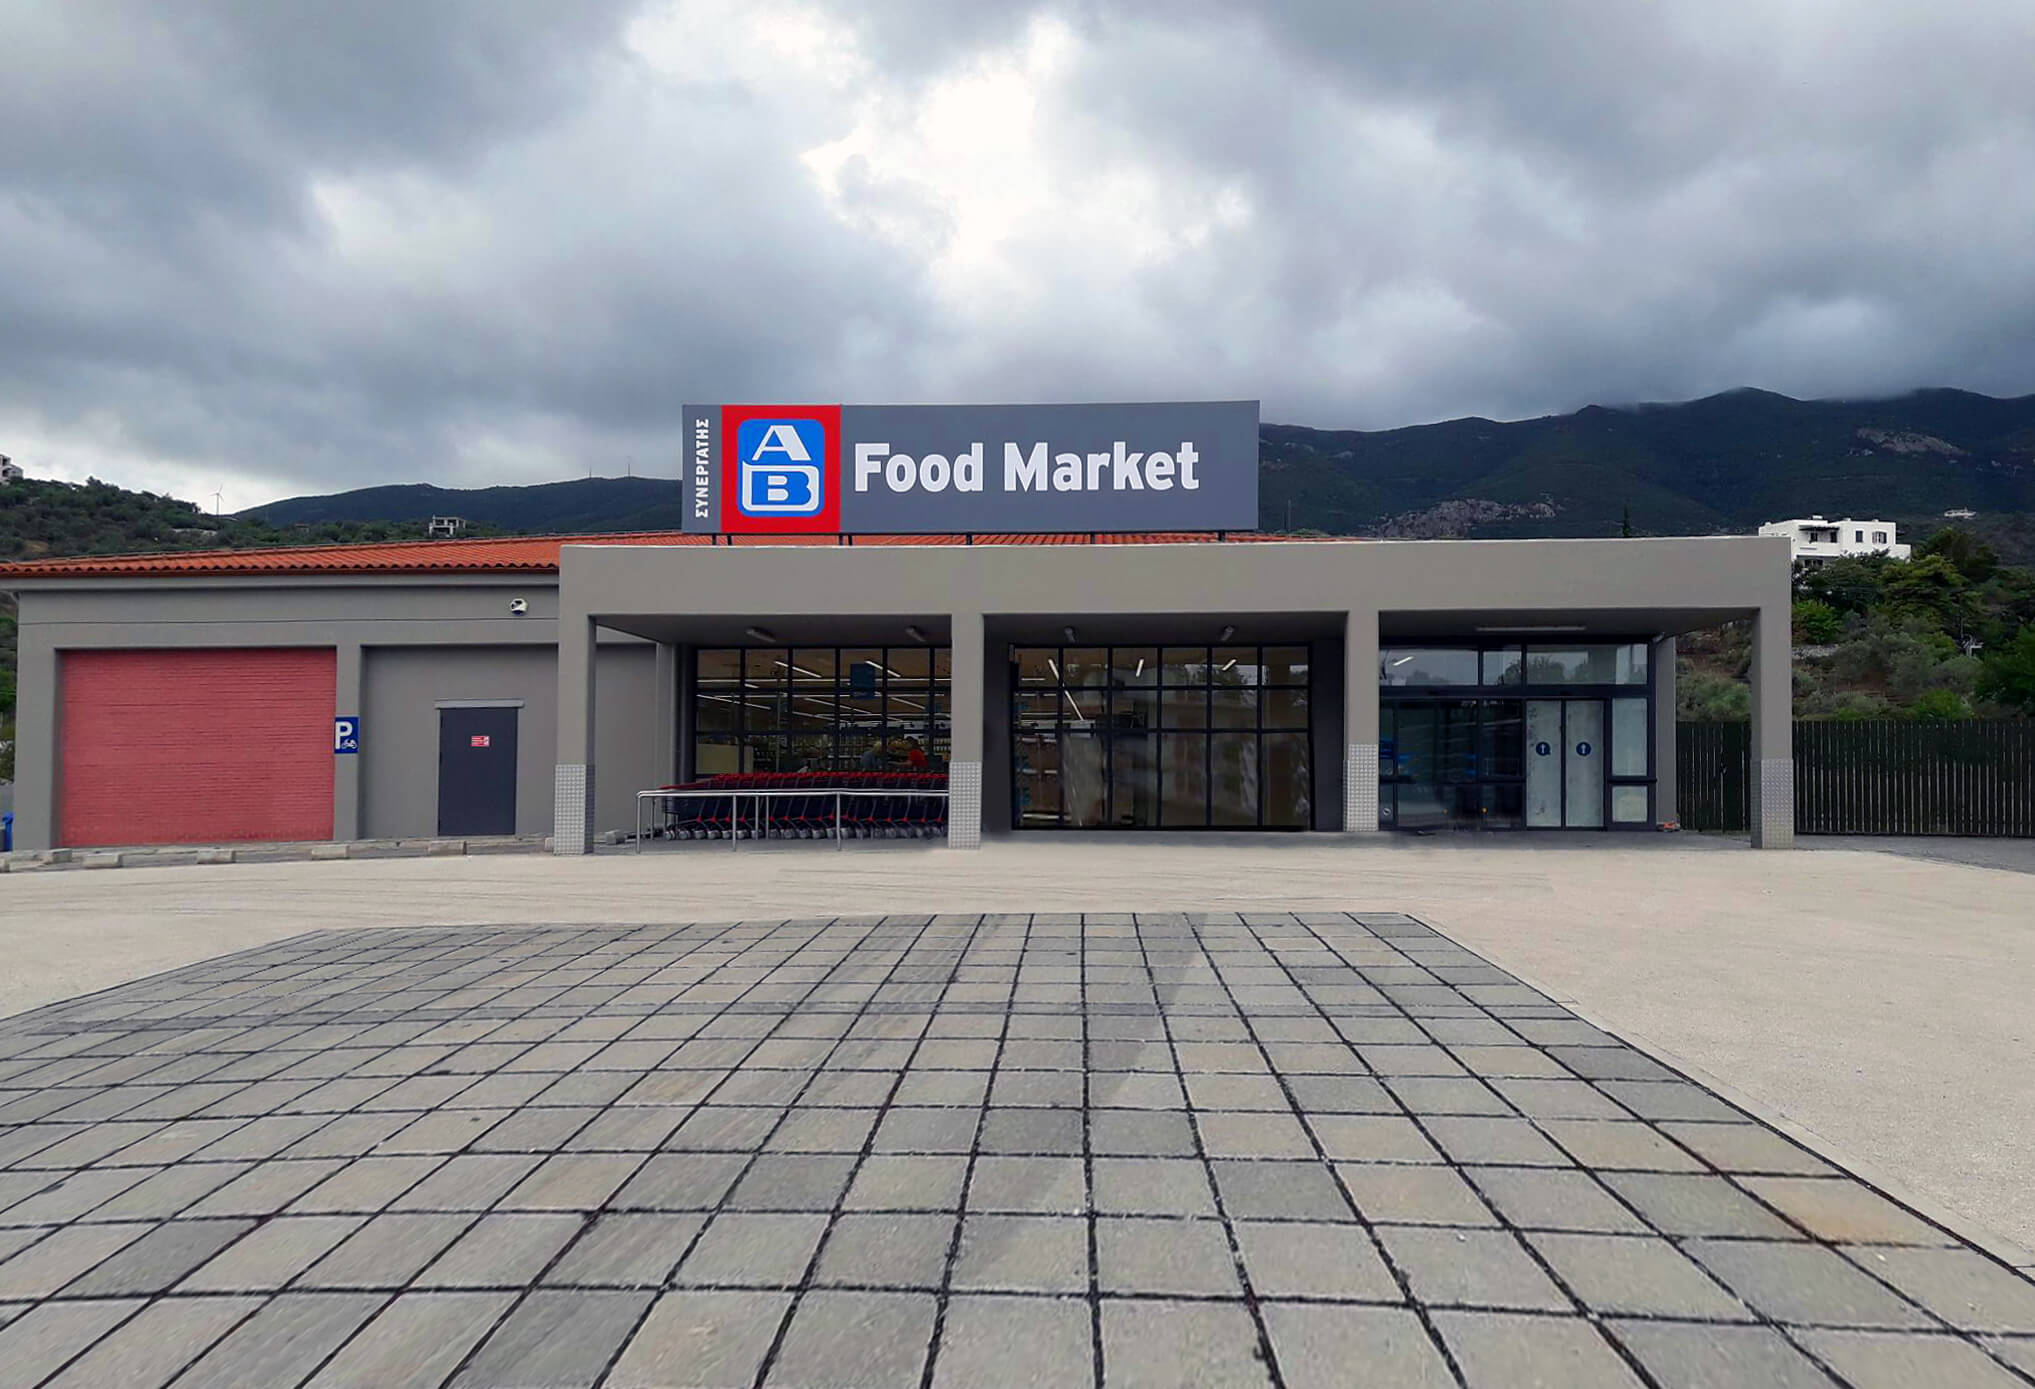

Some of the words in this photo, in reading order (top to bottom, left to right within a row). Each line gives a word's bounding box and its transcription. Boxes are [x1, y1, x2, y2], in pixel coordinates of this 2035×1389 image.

[695, 418, 709, 518] ΣΥΝΕΡΓΑΤΗΣ
[855, 442, 984, 493] Food
[1004, 441, 1199, 493] Market
[335, 721, 353, 750] P
